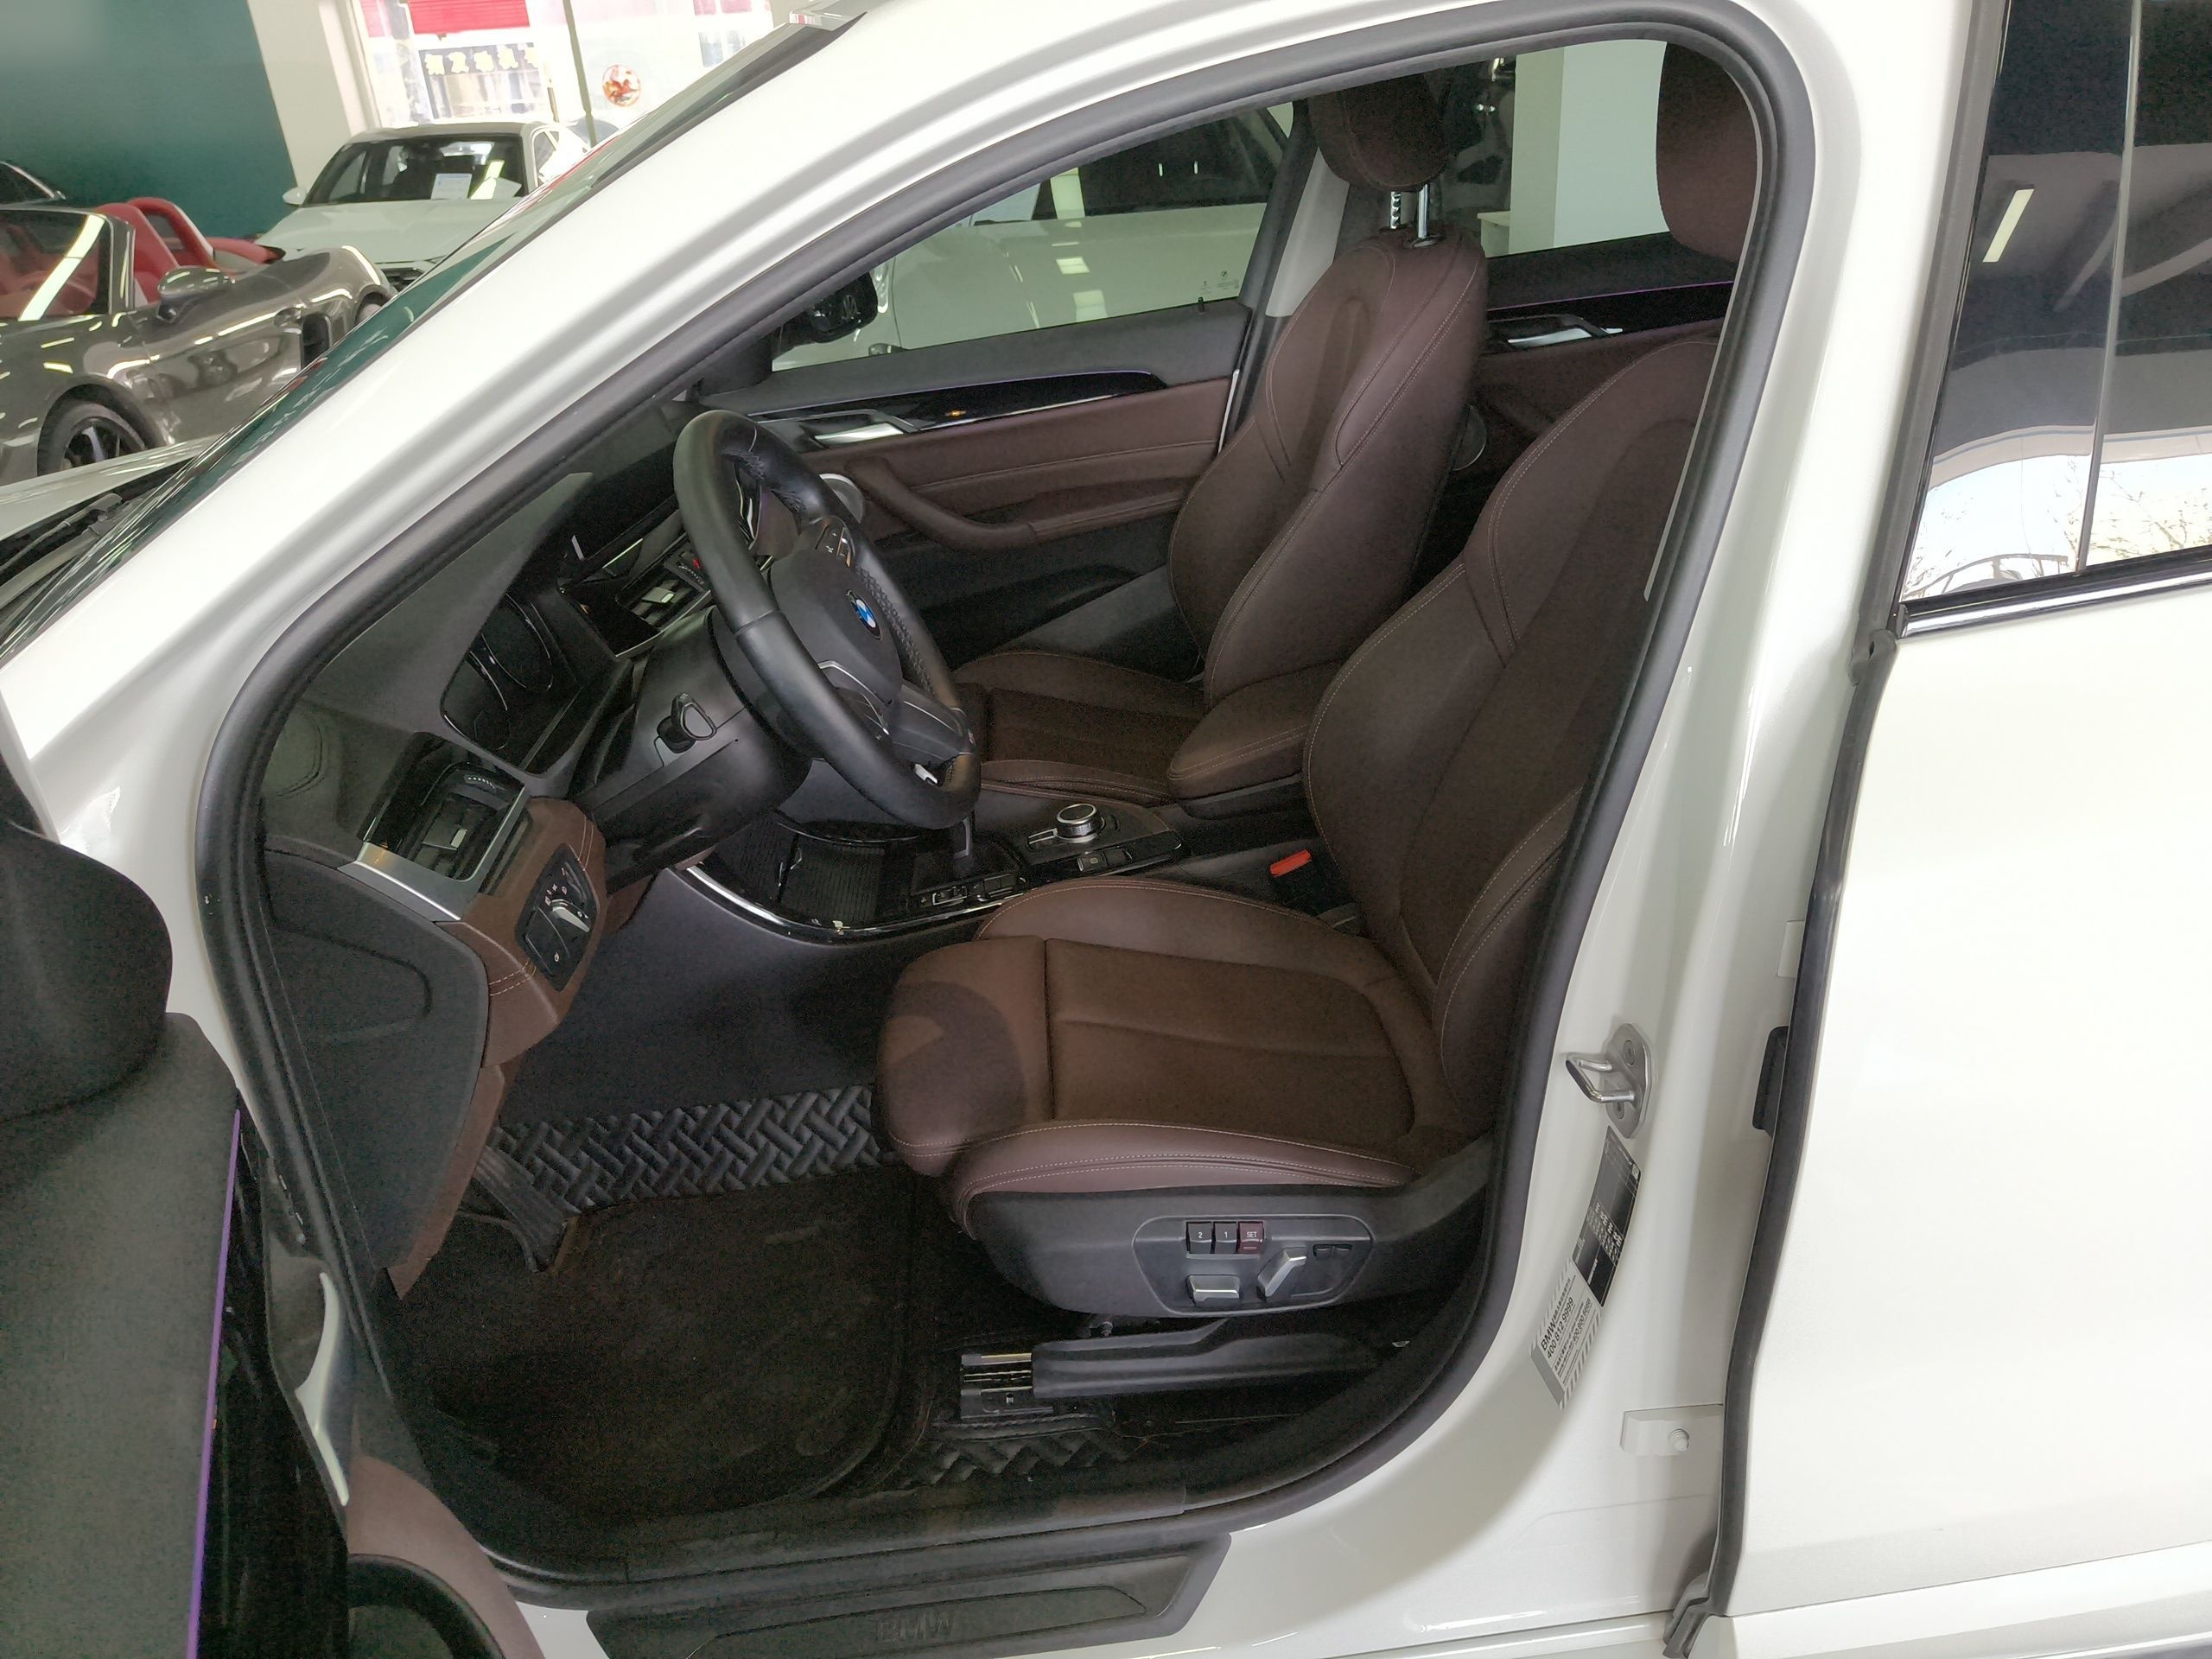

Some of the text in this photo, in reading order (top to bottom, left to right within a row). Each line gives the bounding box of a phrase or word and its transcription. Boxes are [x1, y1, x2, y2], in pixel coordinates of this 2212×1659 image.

[1540, 1318, 1556, 1351] BMW
[1546, 1338, 1556, 1360] 400
[1554, 1319, 1564, 1342] 812
[1561, 1296, 1573, 1323] 9999
